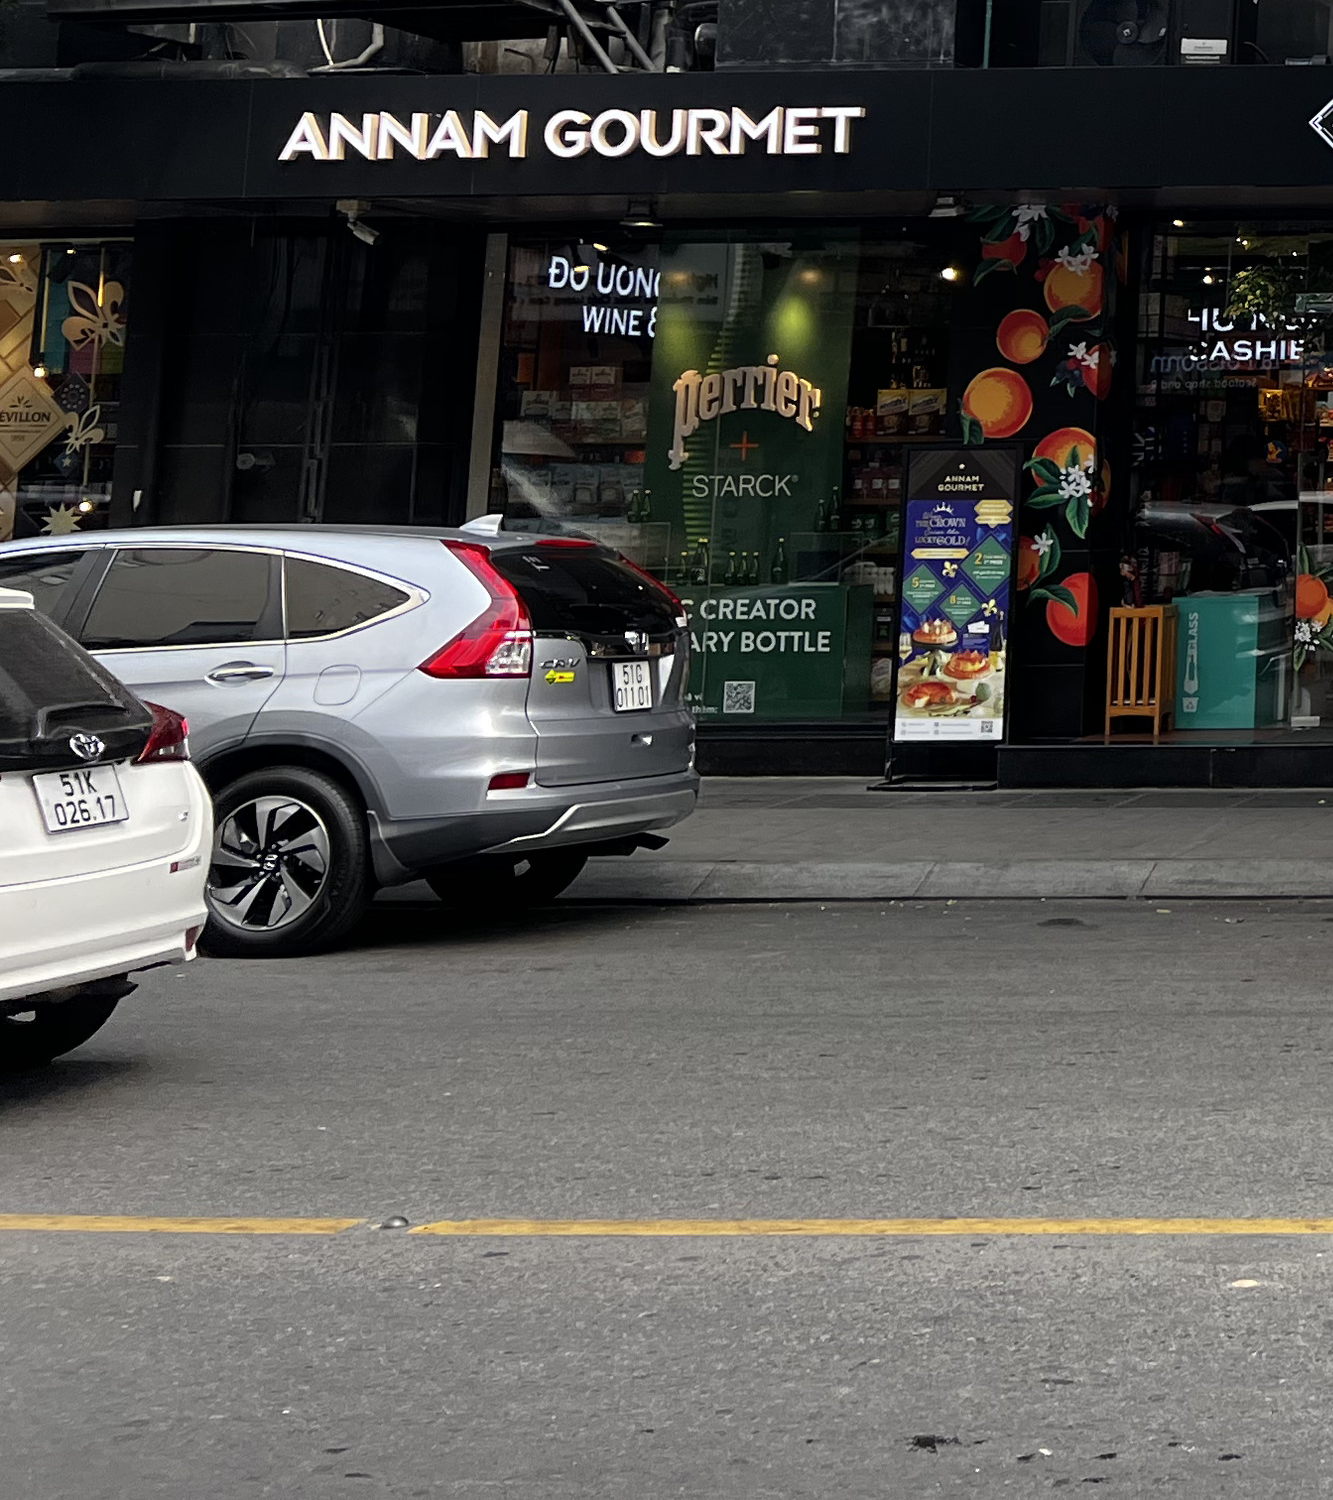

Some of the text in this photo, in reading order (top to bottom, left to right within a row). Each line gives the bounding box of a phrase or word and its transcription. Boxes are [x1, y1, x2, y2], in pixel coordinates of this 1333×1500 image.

[278, 106, 865, 160] ANNAM GOURMET
[582, 305, 643, 336] WINE
[1189, 340, 1305, 361] CASHIE
[0, 410, 51, 422] ÉVILLON
[692, 475, 793, 498] STARCK
[930, 518, 967, 528] CROWN
[974, 553, 983, 565] 2
[912, 577, 920, 588] 5
[700, 599, 817, 620] CREATOR
[690, 631, 831, 653] ARY BOTTLE
[1187, 612, 1199, 654] GLASS
[623, 664, 643, 686] 51G
[617, 686, 650, 708] 011.01
[59, 771, 97, 797] 51K
[54, 794, 116, 826] 026.17
